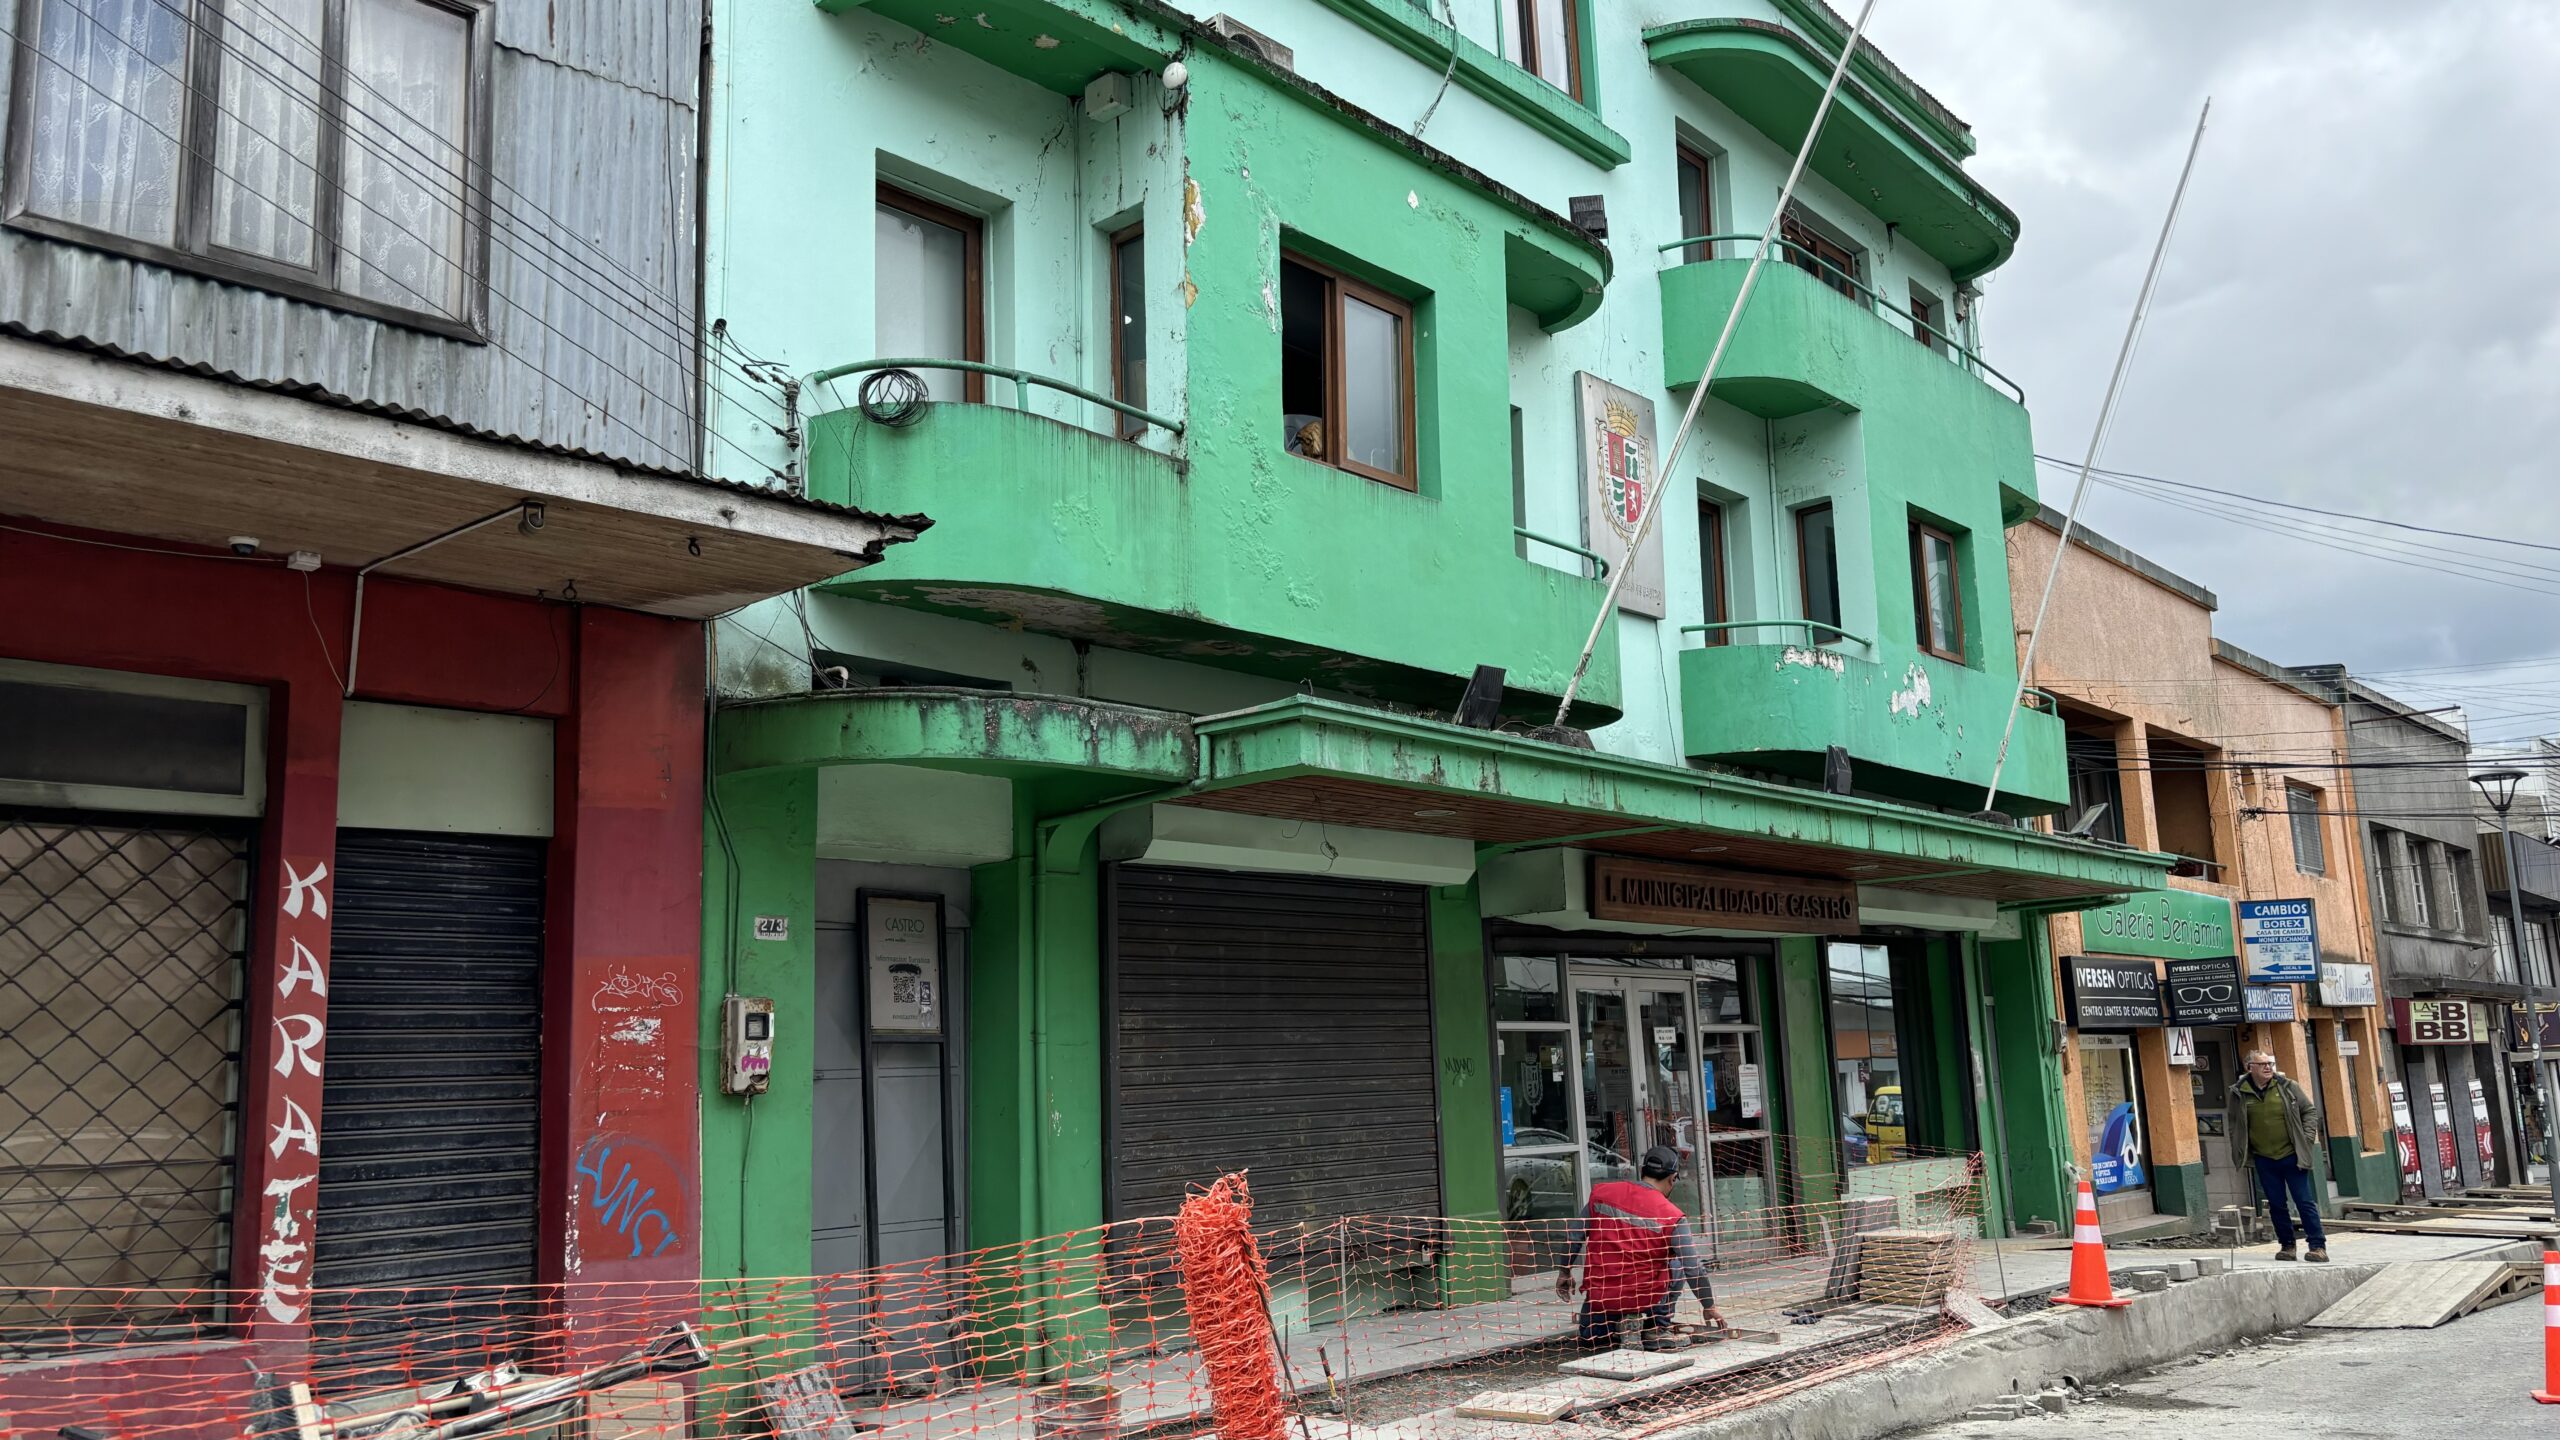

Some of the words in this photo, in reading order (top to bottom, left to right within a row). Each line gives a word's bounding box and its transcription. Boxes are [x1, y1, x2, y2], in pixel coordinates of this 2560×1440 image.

[1624, 878, 1761, 913] MUNICIPALIDAD
[1765, 892, 1786, 915] DE
[1790, 893, 1852, 920] CASTRO
[2254, 904, 2307, 916] CAMBIOS
[761, 919, 783, 931] 273
[885, 917, 925, 933] CASTRO
[2095, 901, 2155, 940] Galería
[2160, 897, 2224, 954] Benjamín
[2263, 920, 2301, 928] BOREX
[2076, 967, 2115, 988] IVERSEN
[2117, 971, 2155, 990] OPTICAS
[2244, 989, 2272, 1009] AMBIOS
[2273, 993, 2291, 1006] BOREX
[2081, 1006, 2102, 1016] CENTRO
[2104, 1006, 2122, 1016] LENTES
[2123, 1006, 2131, 1016] DE
[2131, 1006, 2158, 1016] CONTACTO
[2179, 1008, 2202, 1016] RECETA
[2214, 1006, 2238, 1014] LENTES
[2413, 1002, 2439, 1011] LAS
[2440, 1002, 2466, 1021] B
[2267, 1012, 2294, 1020] EXCHANGE
[260, 859, 328, 1324] KARATE
